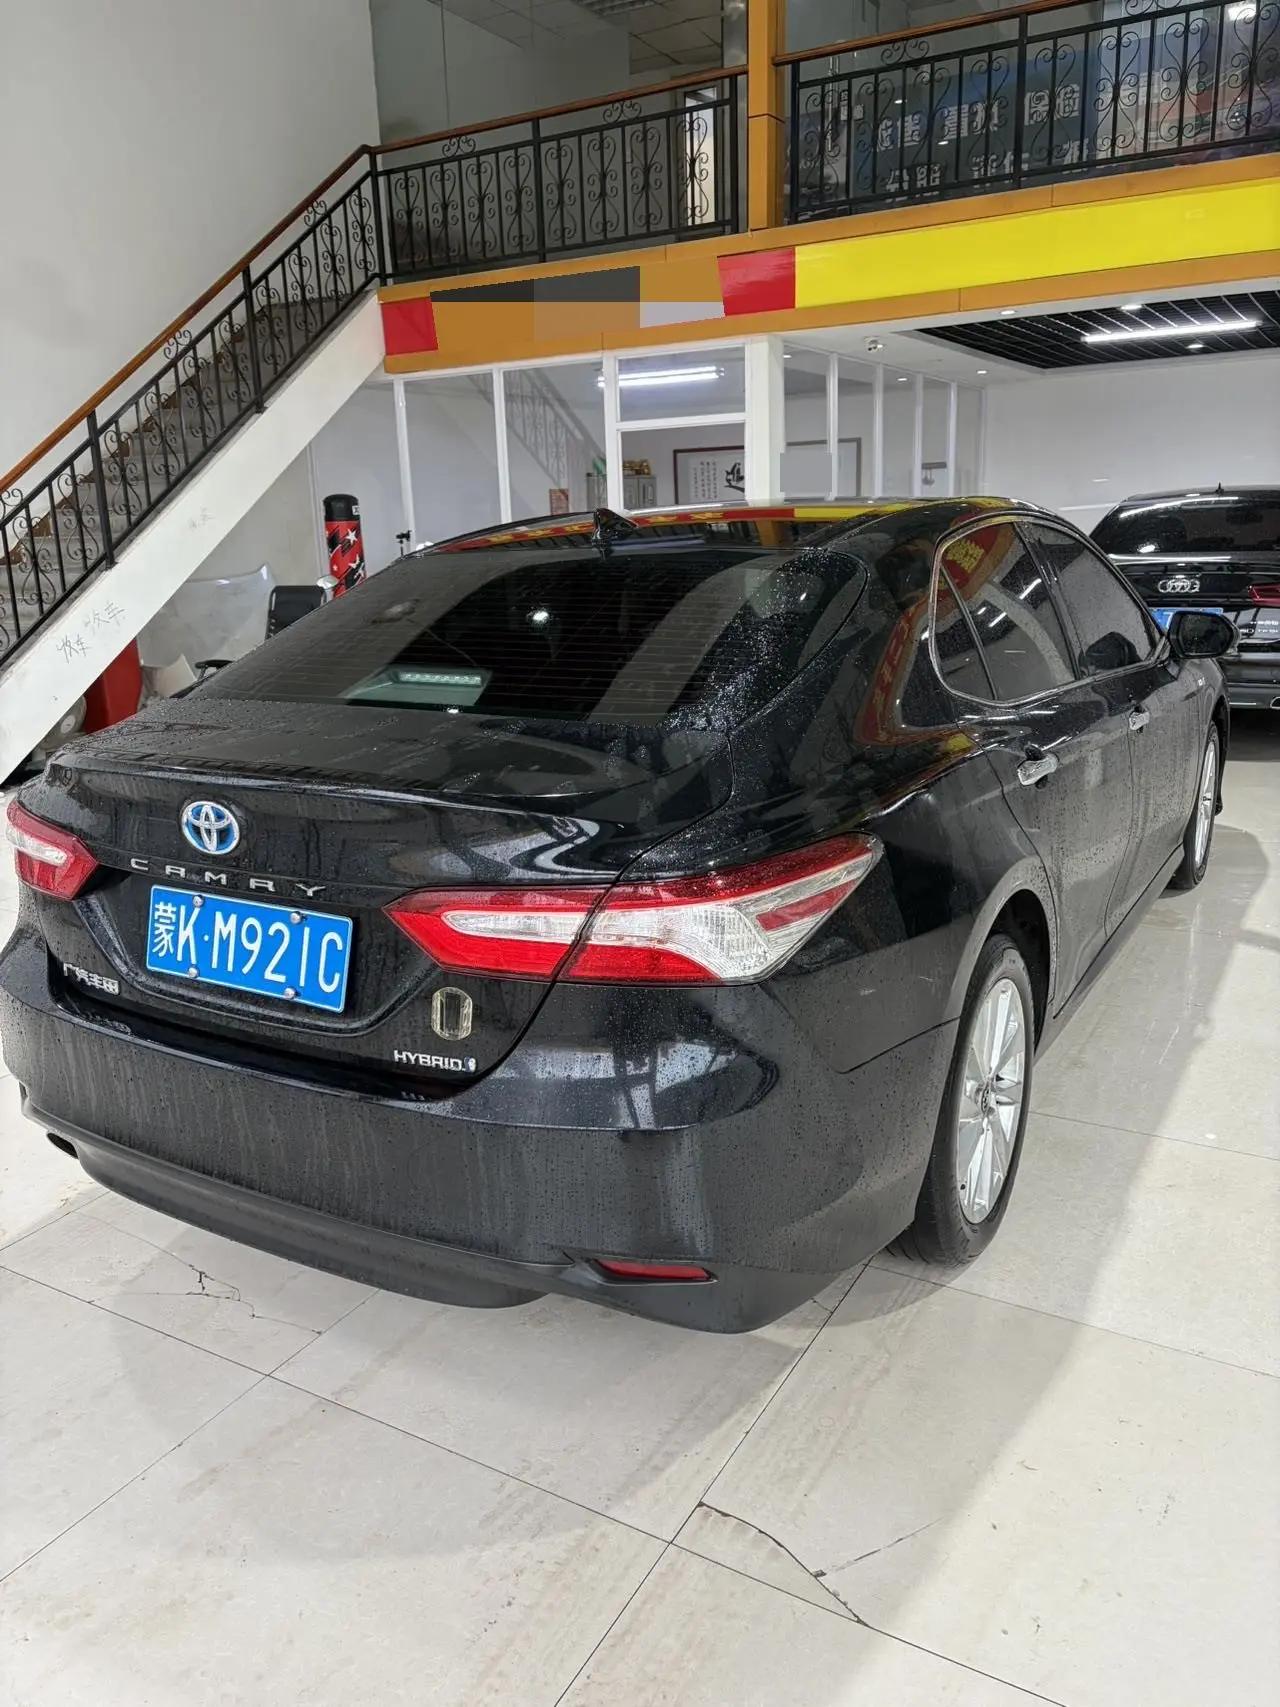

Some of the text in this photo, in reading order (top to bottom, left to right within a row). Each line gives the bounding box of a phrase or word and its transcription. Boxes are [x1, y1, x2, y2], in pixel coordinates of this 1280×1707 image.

[130, 857, 326, 897] CAMRY
[152, 901, 344, 994] 蒙K·M921C
[393, 1049, 463, 1072] HYBRID
